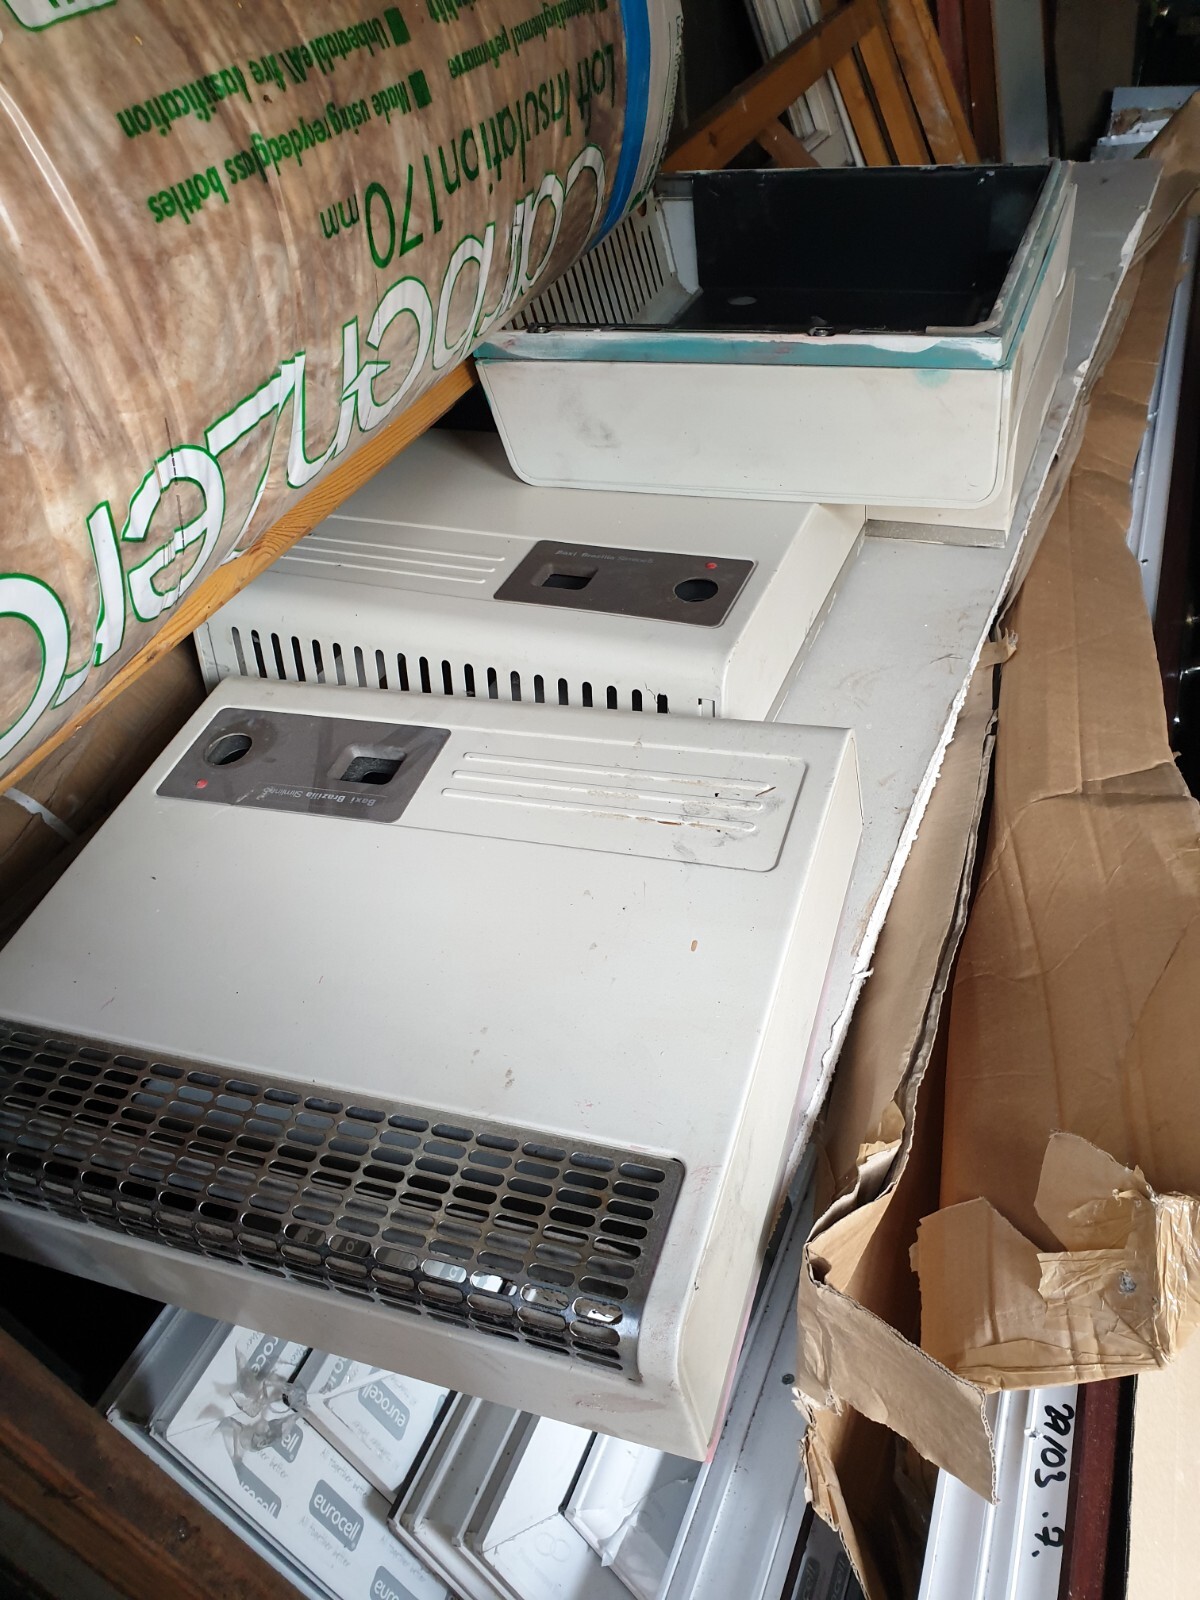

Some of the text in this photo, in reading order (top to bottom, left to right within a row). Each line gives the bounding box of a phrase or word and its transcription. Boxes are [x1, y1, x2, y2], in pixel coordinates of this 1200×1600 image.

[301, 17, 391, 76] Unbeatable
[372, 81, 413, 125] Made
[576, 43, 615, 137] Loft
[326, 98, 371, 134] using
[438, 67, 572, 194] Insulation
[147, 165, 229, 224] bottles
[319, 193, 359, 240] mm
[364, 154, 443, 268] 170
[305, 790, 347, 803] Brazilia
[350, 796, 377, 807] Baxi
[313, 1493, 361, 1541] eurocell
